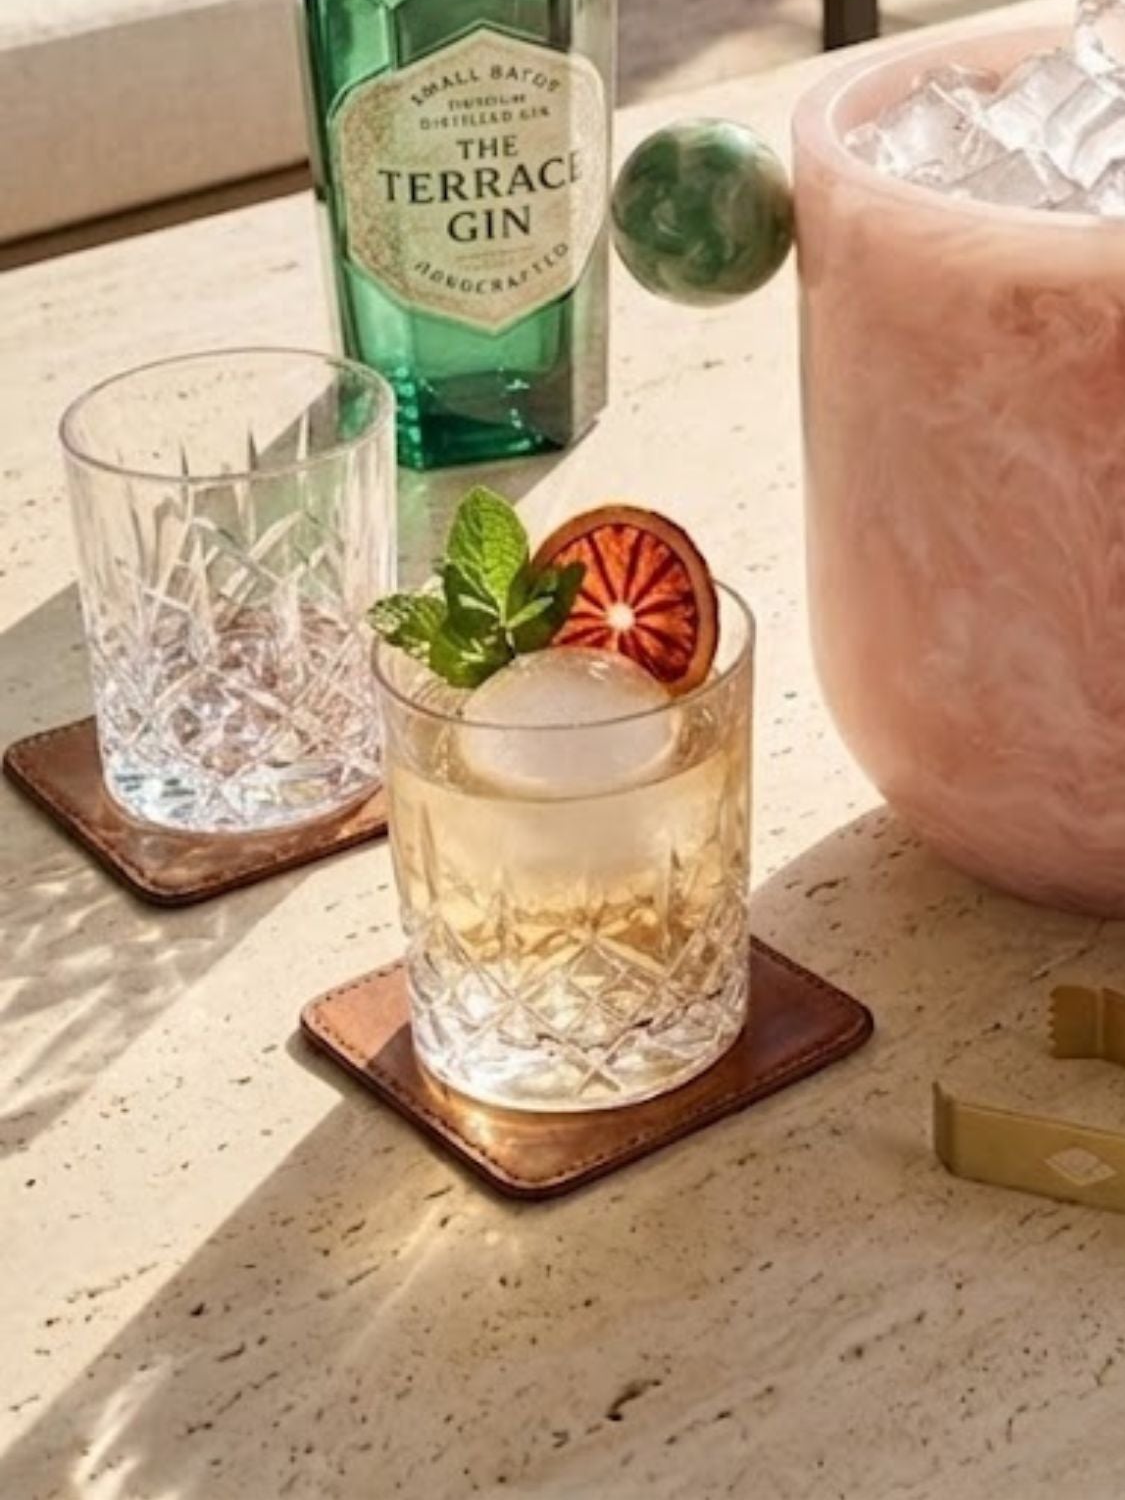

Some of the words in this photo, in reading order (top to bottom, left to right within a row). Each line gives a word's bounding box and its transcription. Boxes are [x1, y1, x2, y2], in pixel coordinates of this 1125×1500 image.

[456, 134, 519, 161] THE
[377, 151, 583, 205] TERRACE
[446, 203, 532, 243] GIN
